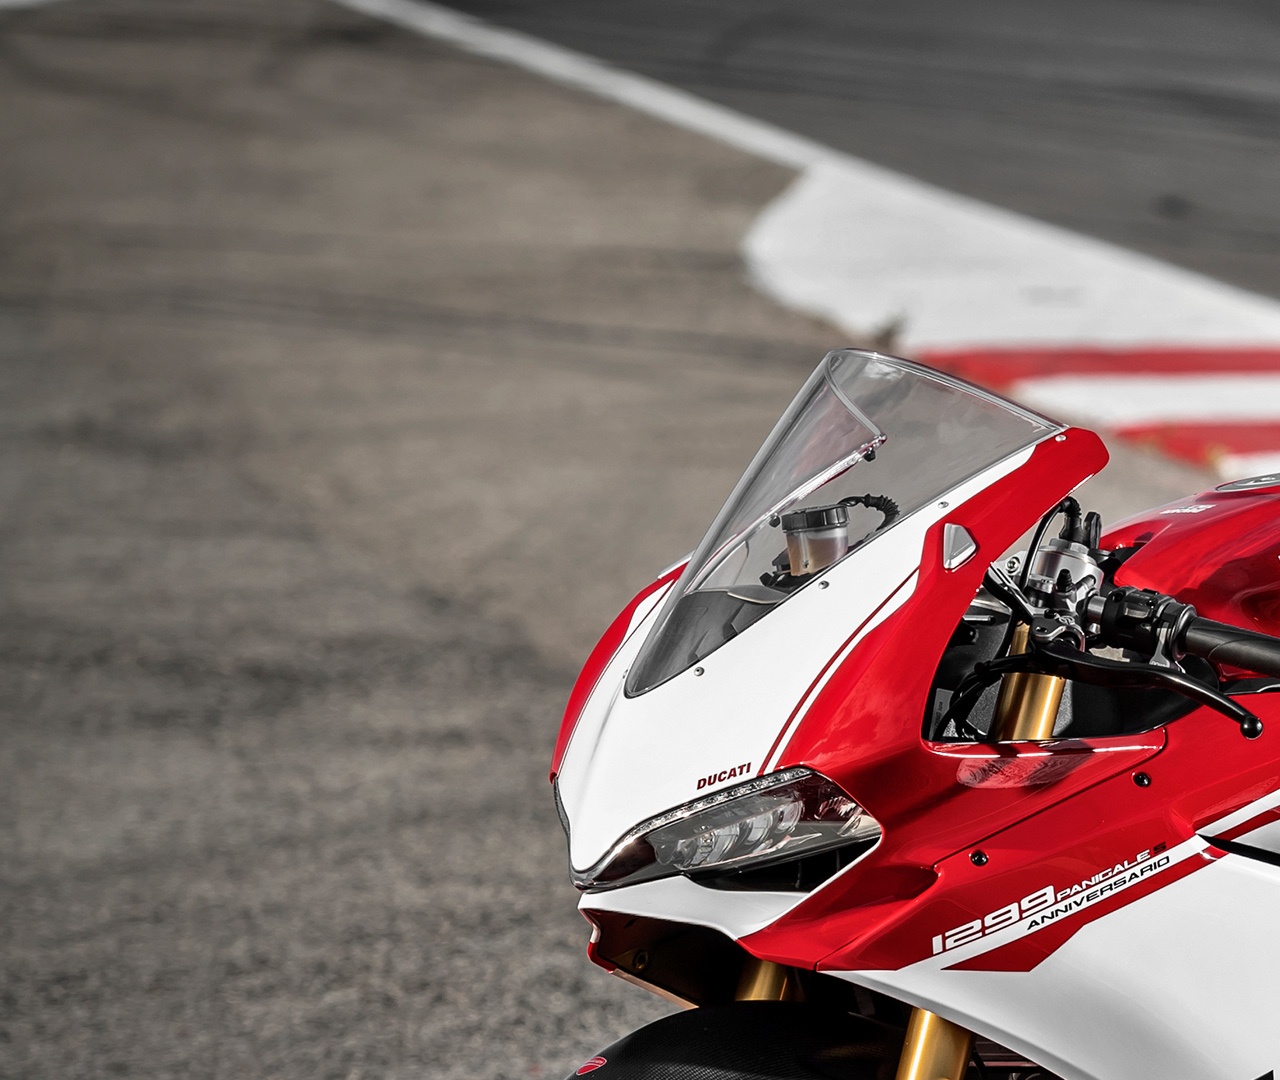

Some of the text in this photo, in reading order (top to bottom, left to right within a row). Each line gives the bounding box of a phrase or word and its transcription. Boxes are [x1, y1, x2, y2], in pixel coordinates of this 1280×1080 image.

[696, 762, 752, 790] DUCATI
[931, 885, 1056, 955] 1299
[1056, 849, 1151, 902] PANIGALE
[1026, 855, 1171, 931] ANNIVERSARIO
